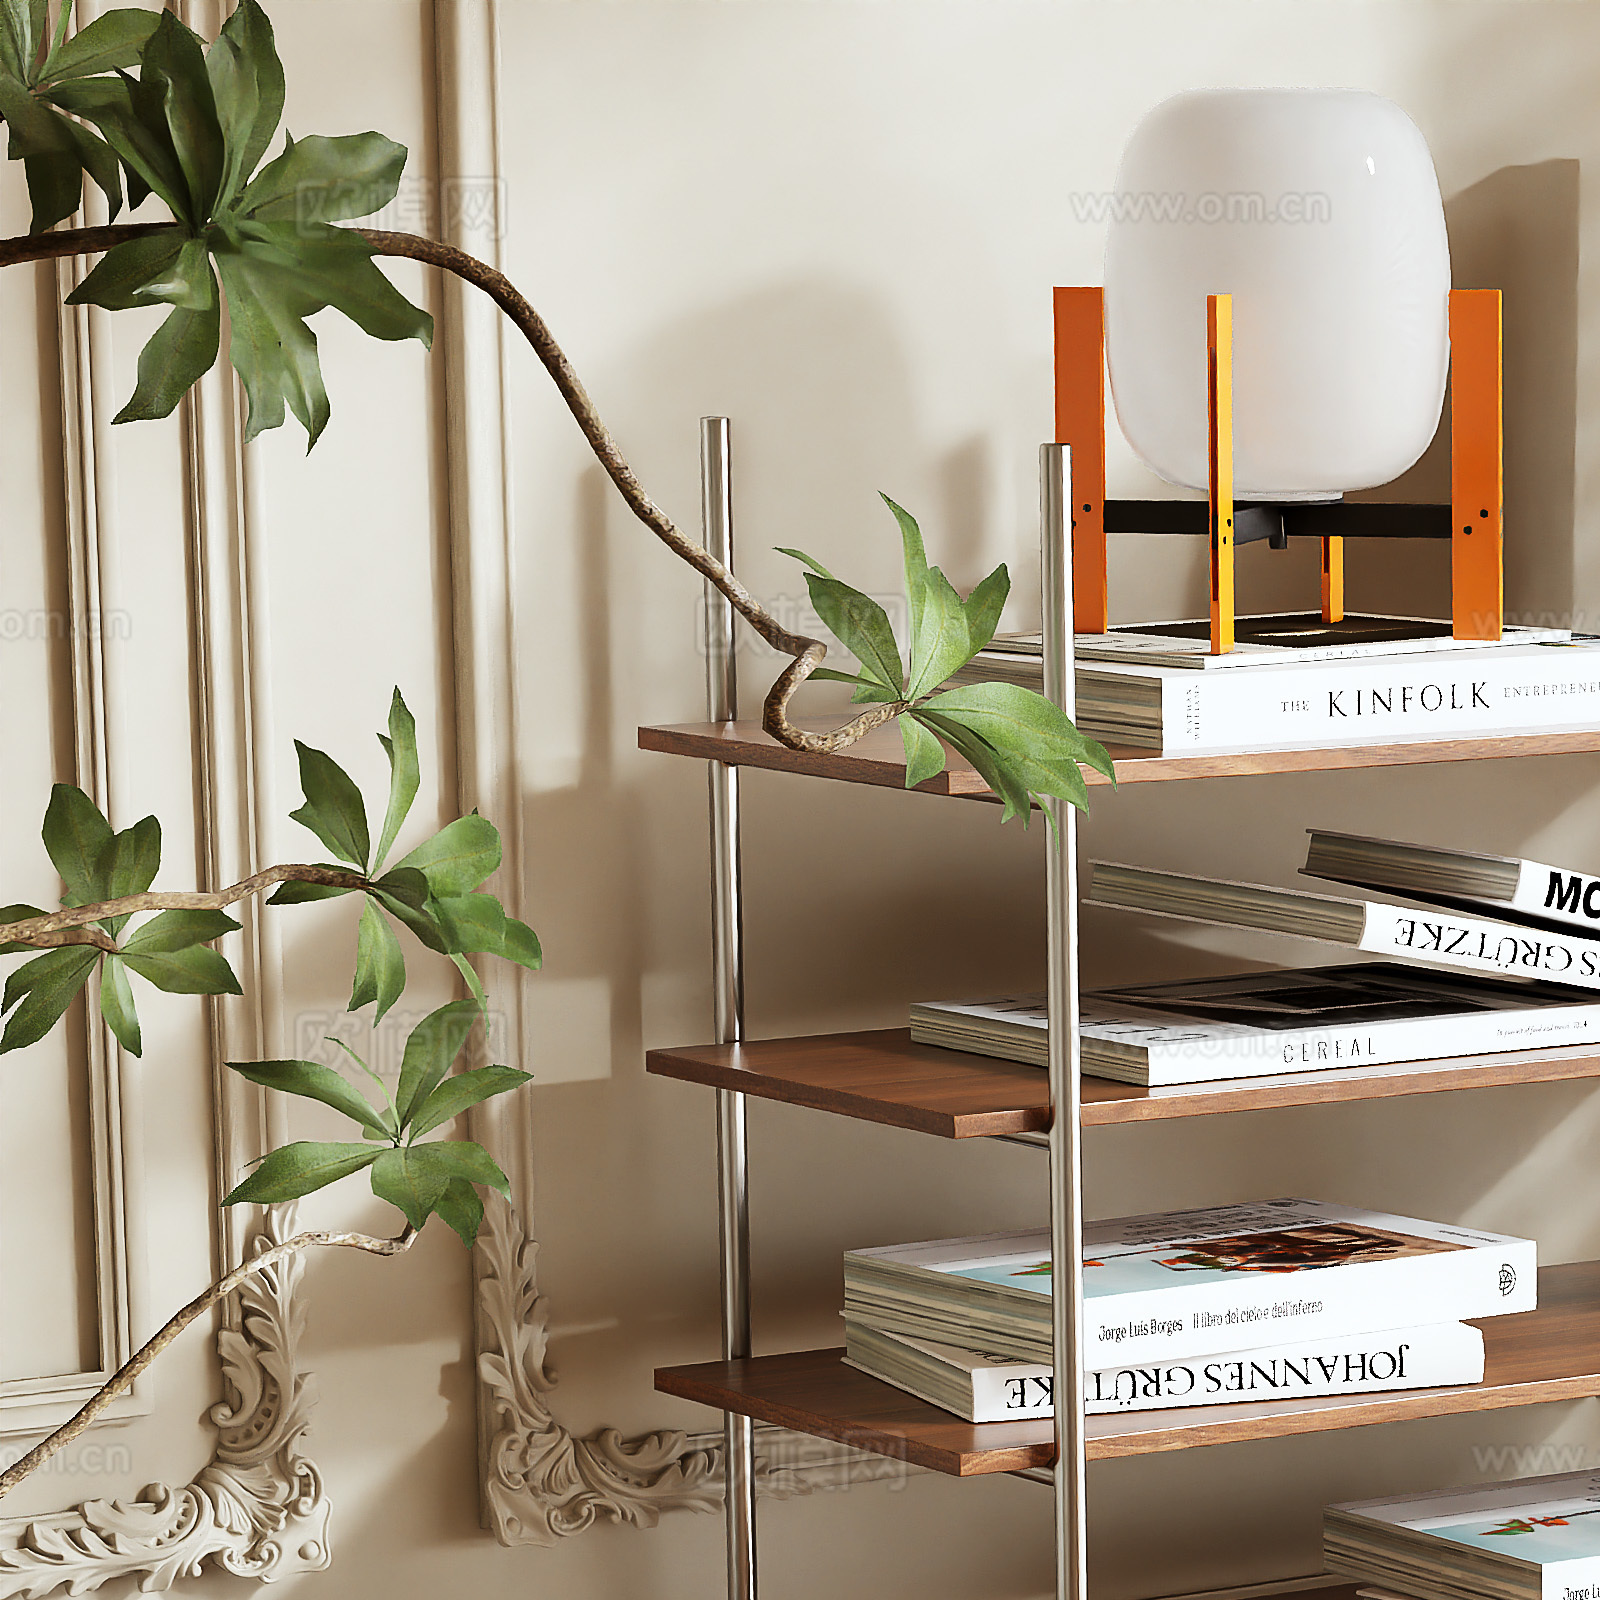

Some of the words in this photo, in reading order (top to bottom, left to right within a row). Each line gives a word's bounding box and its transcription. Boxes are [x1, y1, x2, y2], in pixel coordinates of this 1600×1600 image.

[1280, 700, 1311, 713] THE
[1328, 681, 1490, 718] KINFOLK
[1395, 917, 1572, 972] GRÜTZKE
[1282, 1036, 1377, 1064] CEREAL
[1098, 1323, 1129, 1343] Jorge
[1129, 1320, 1149, 1337] Luis
[1150, 1316, 1183, 1337] Borges
[1201, 1310, 1223, 1327] libro
[1224, 1306, 1239, 1324] del
[1005, 1366, 1195, 1410] GRÜTKE
[1205, 1344, 1410, 1394] JOHANNES
